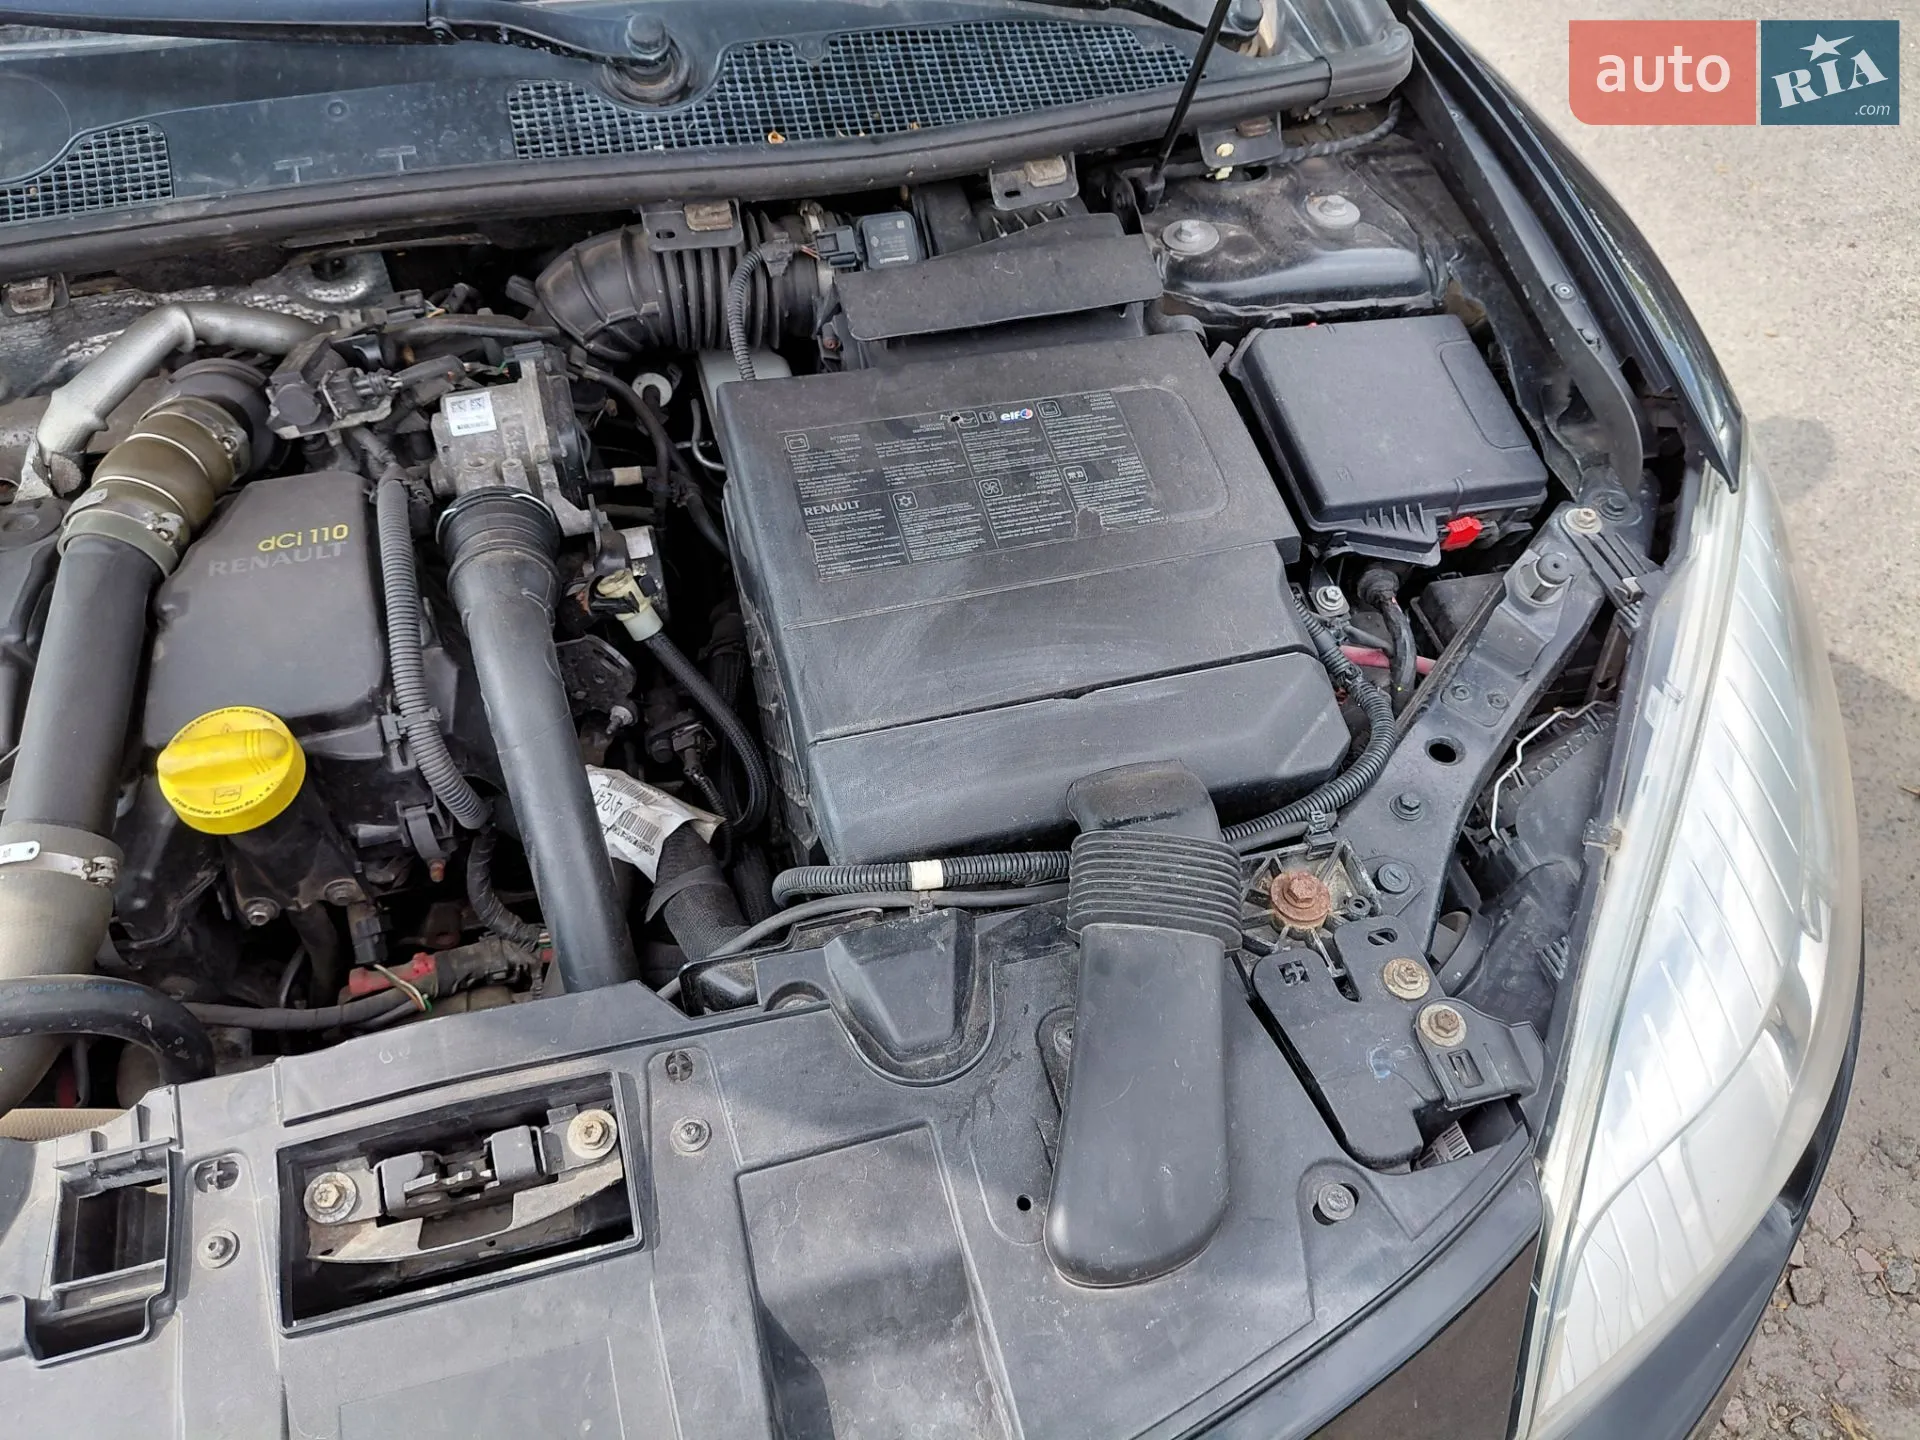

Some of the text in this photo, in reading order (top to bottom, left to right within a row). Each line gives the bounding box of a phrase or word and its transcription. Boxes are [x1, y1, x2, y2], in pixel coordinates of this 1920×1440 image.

[1000, 411, 1021, 421] elf
[803, 499, 861, 516] RENAULT
[258, 523, 349, 552] dCi 110
[208, 541, 347, 577] RENAULT
